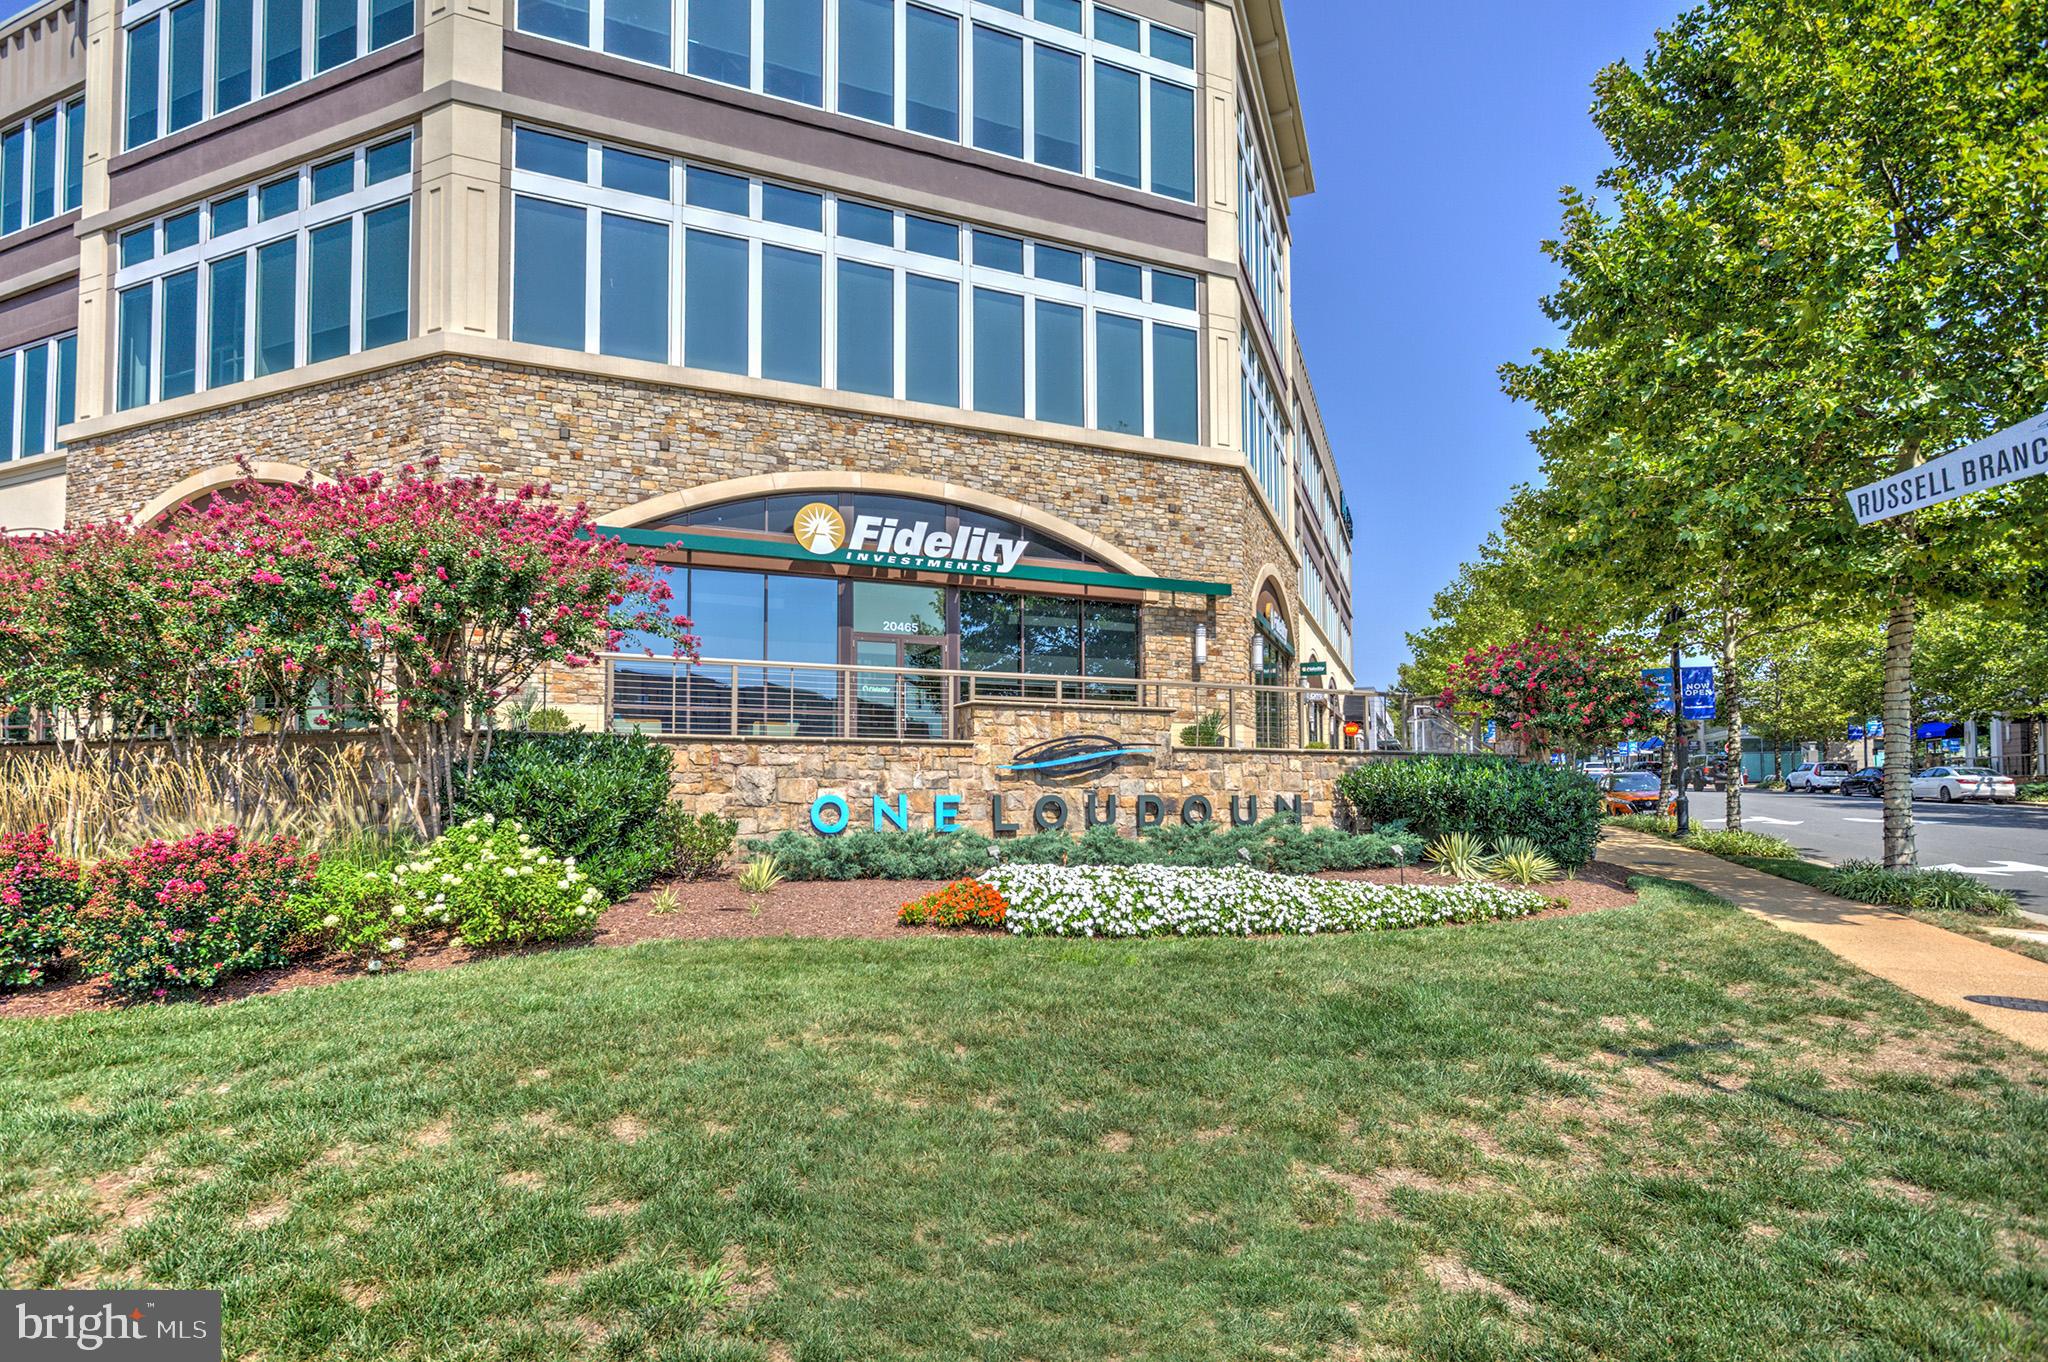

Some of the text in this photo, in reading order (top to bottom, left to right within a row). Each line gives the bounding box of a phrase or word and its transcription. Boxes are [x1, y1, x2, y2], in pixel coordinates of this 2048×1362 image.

[1857, 437, 2048, 518] RUSSELL BRANC
[846, 551, 992, 573] INVESTMENTS
[848, 514, 1030, 574] Fidelity
[883, 621, 919, 633] 20465
[810, 793, 1301, 834] ONE LOUDOUN
